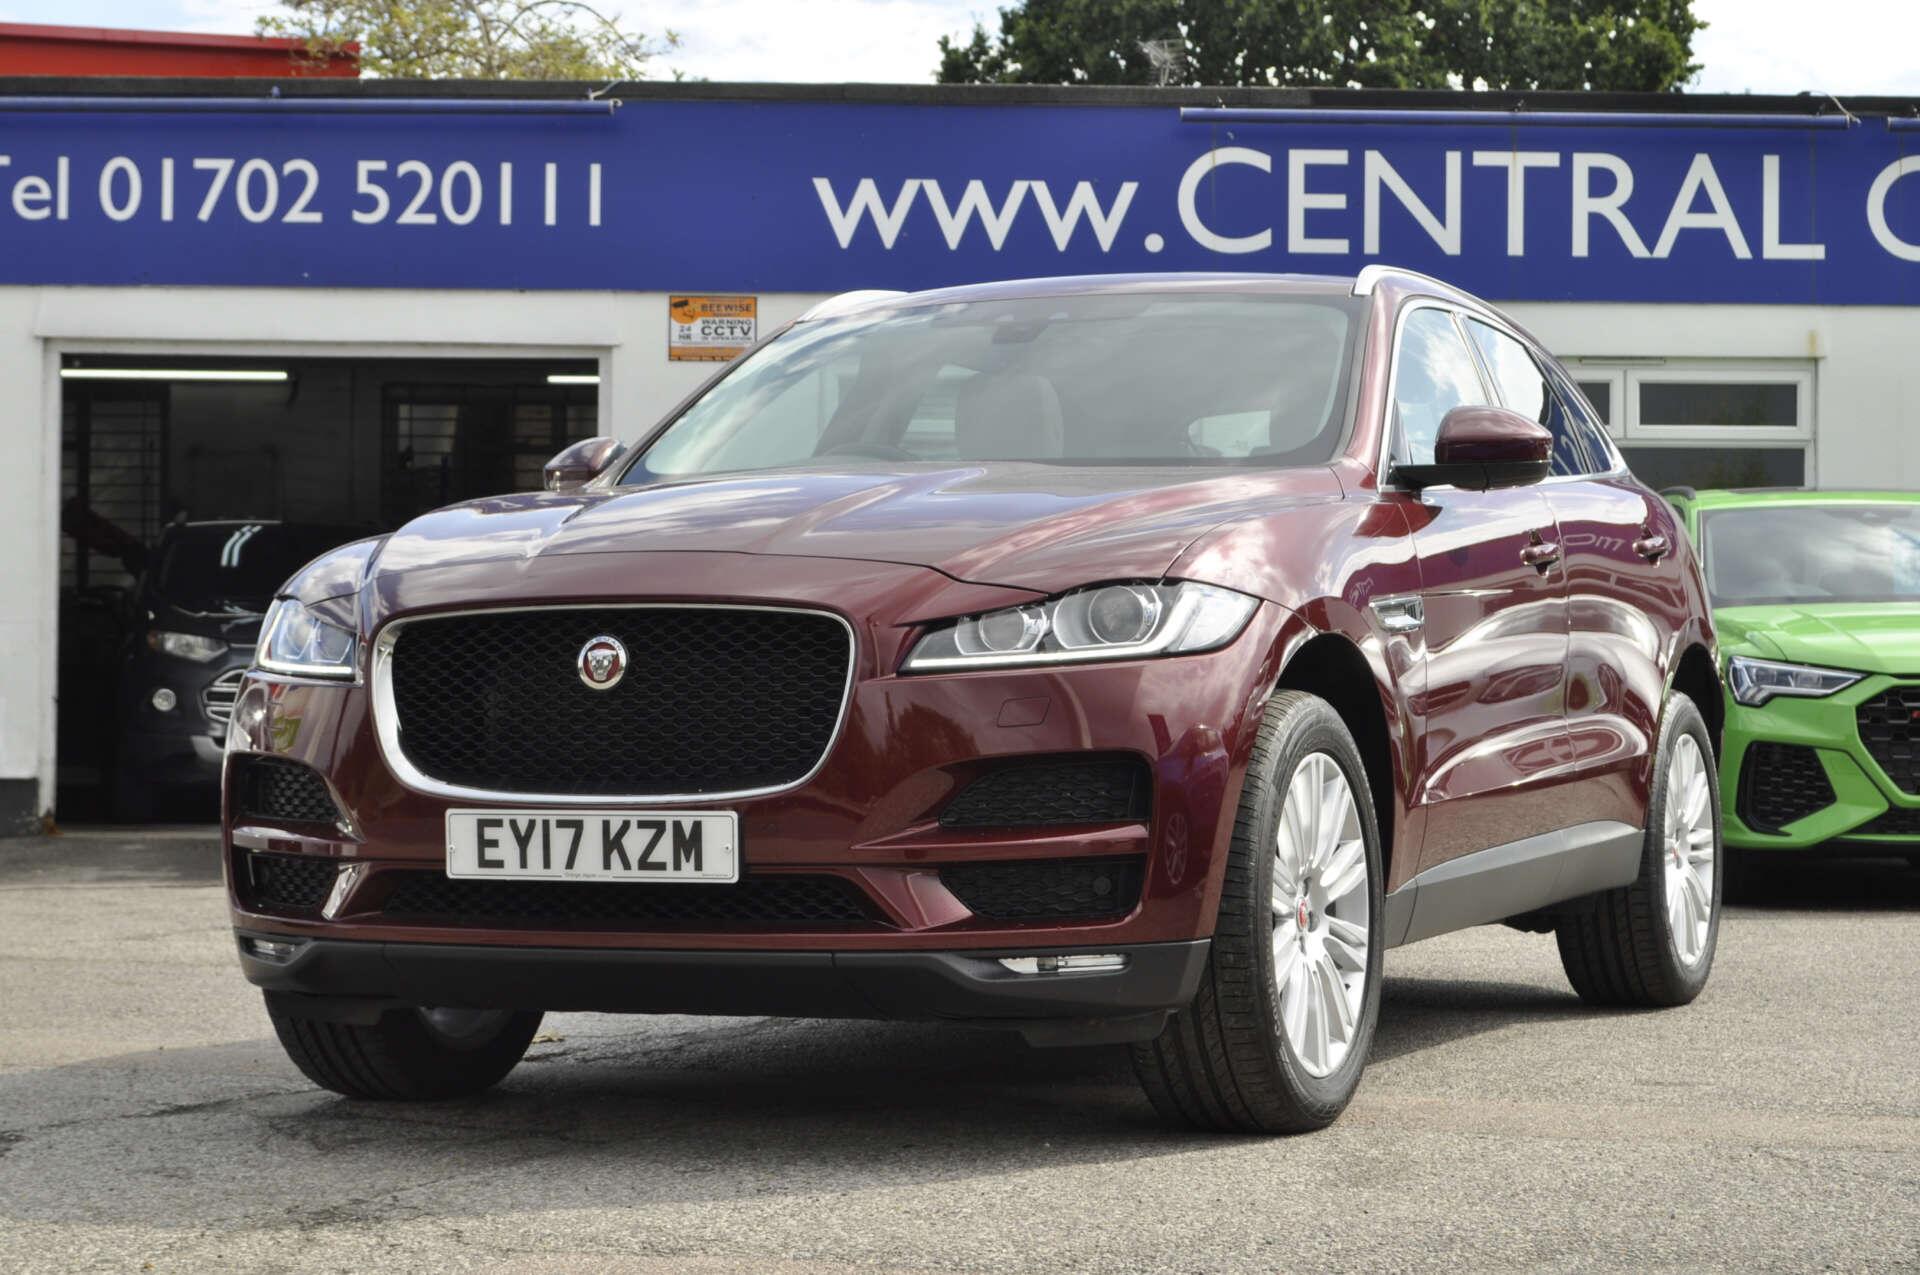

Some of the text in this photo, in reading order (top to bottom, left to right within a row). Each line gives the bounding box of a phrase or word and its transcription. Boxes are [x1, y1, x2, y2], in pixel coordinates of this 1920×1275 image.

[0, 155, 602, 226] el 01702 520111
[701, 303, 752, 313] BEEWISE
[700, 325, 752, 336] CCTV
[476, 818, 704, 872] EY17 KZM
